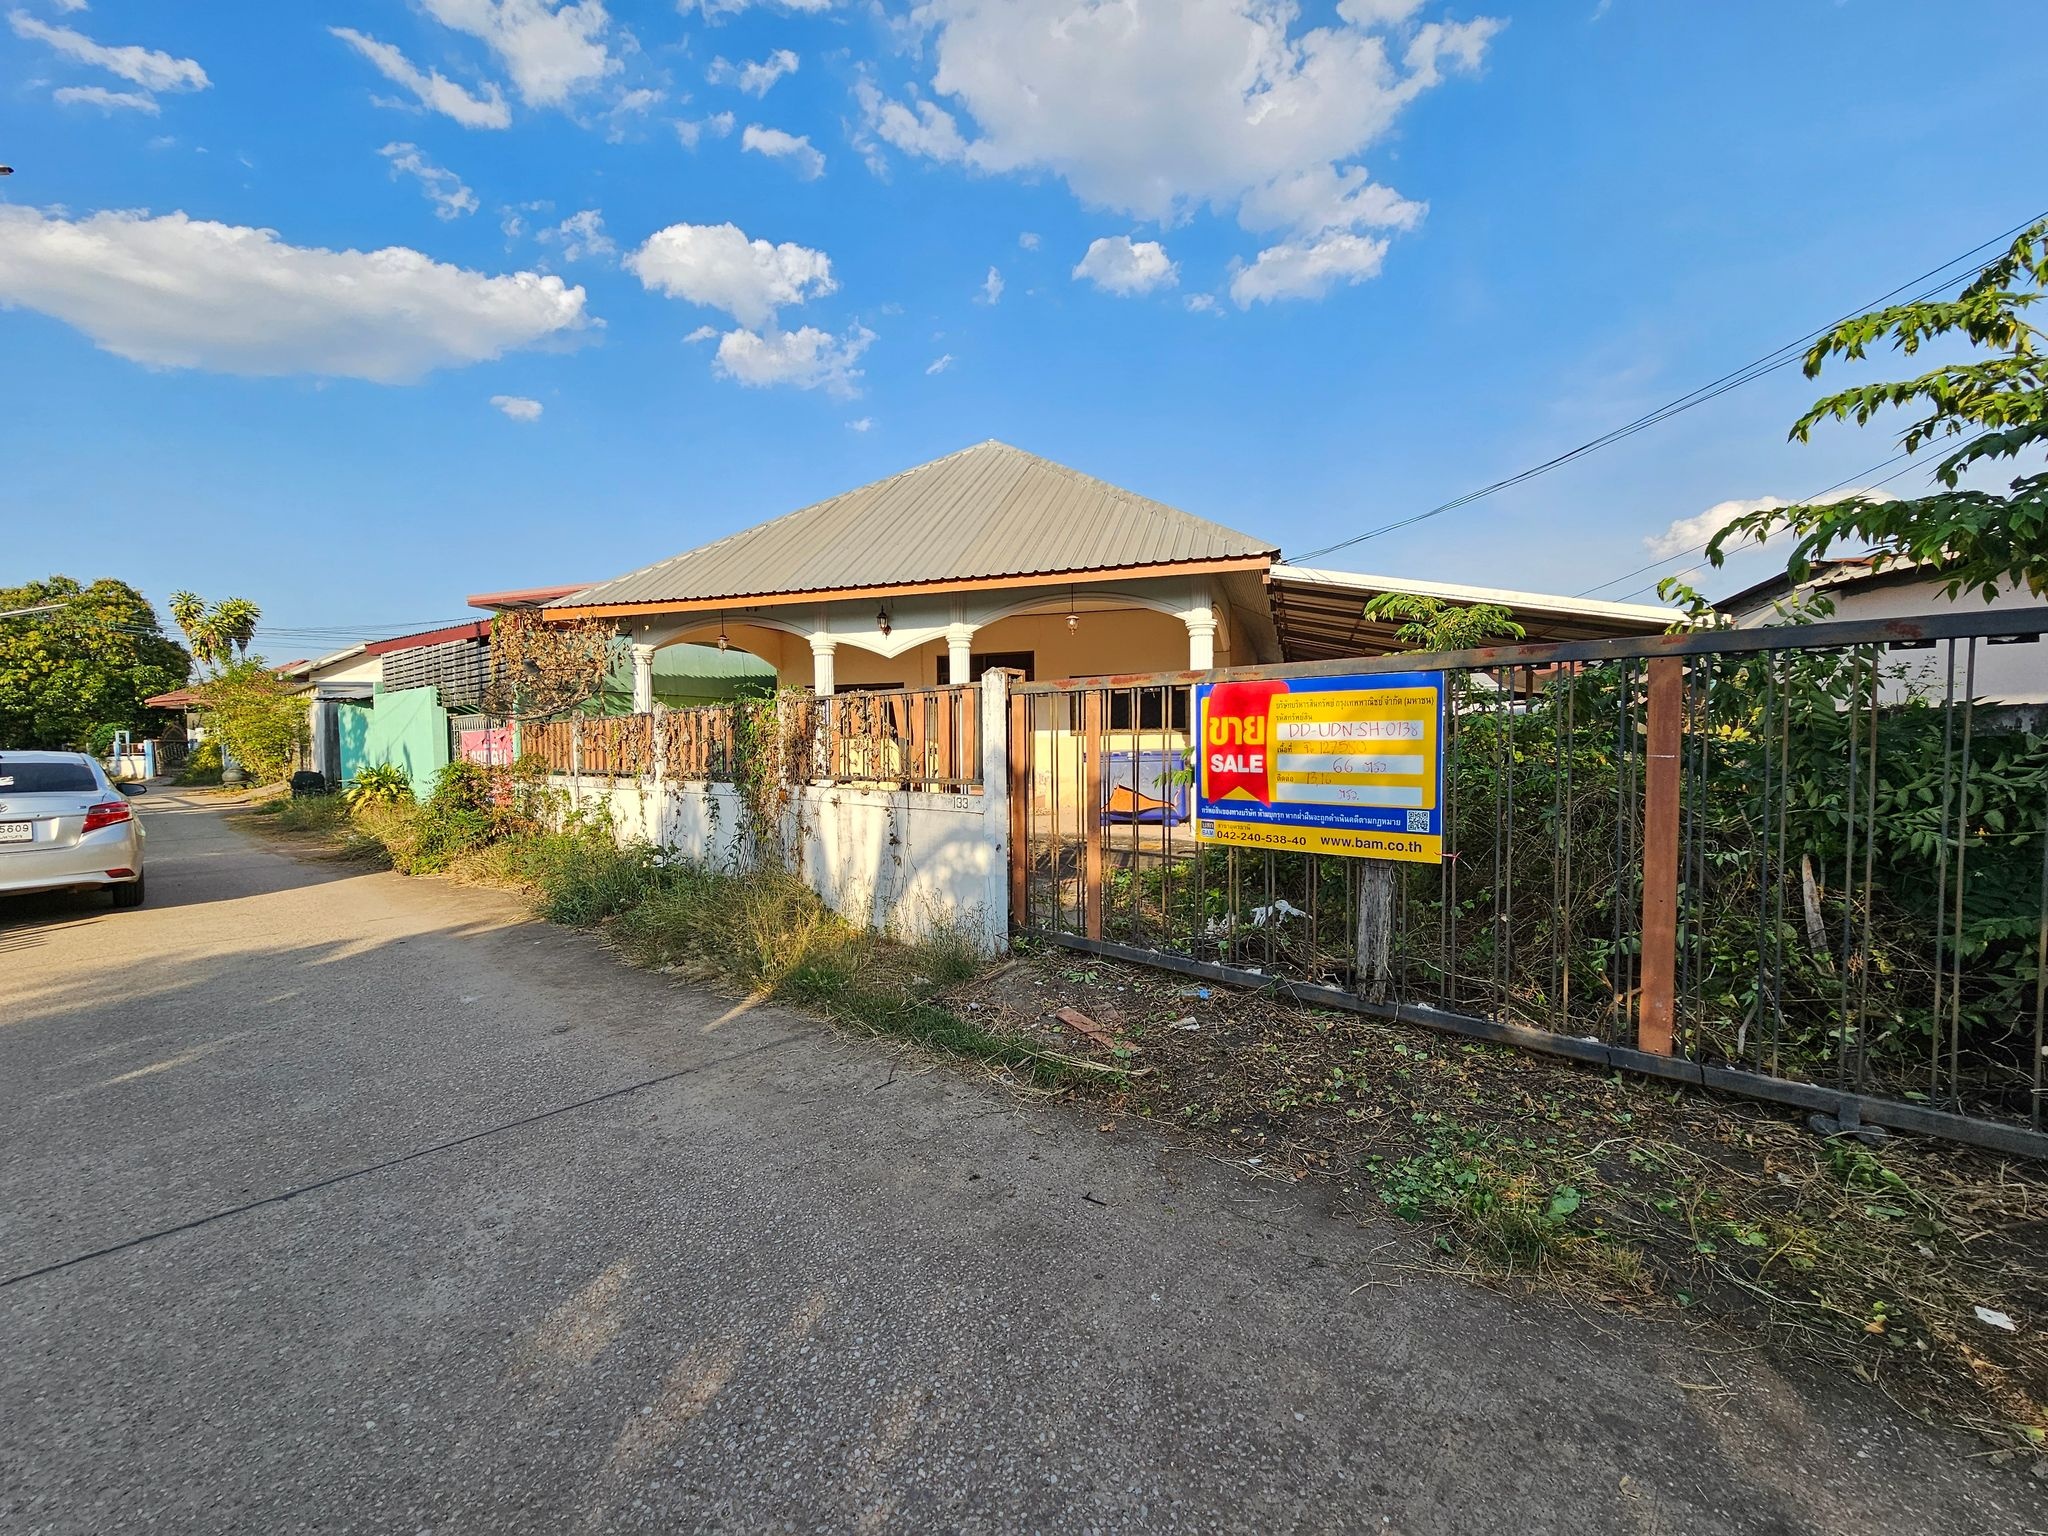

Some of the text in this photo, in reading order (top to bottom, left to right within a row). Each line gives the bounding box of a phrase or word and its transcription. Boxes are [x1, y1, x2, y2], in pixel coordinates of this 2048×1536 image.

[1209, 715, 1265, 746] ขาย
[1210, 754, 1264, 774] SALE
[1332, 757, 1353, 773] 66
[953, 797, 968, 809] 133
[1217, 830, 1422, 853] 042-240-538-40 www.bam.co.th
